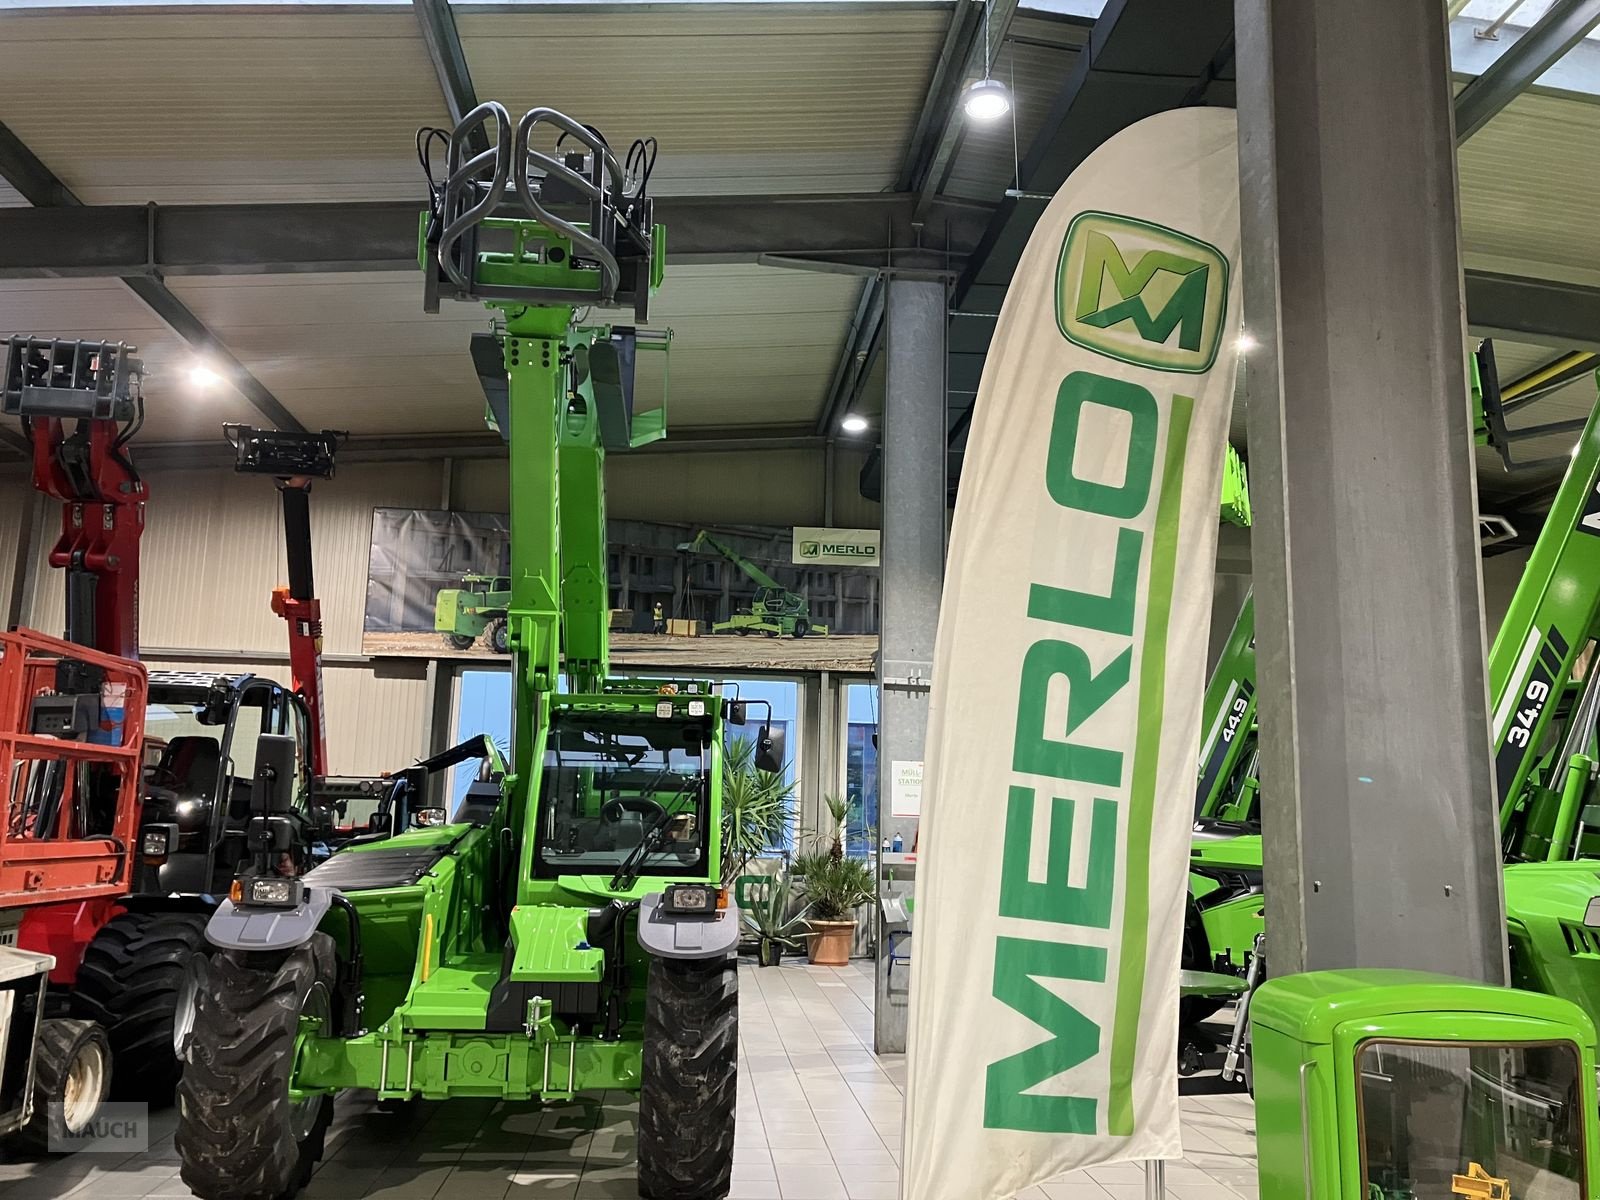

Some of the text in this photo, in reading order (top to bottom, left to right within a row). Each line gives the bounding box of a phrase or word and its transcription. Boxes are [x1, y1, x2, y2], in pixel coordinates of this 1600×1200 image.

[822, 544, 876, 555] MERLO
[1222, 698, 1248, 742] 44.9
[1507, 680, 1549, 748] 34.9
[983, 370, 1158, 1135] MERLO
